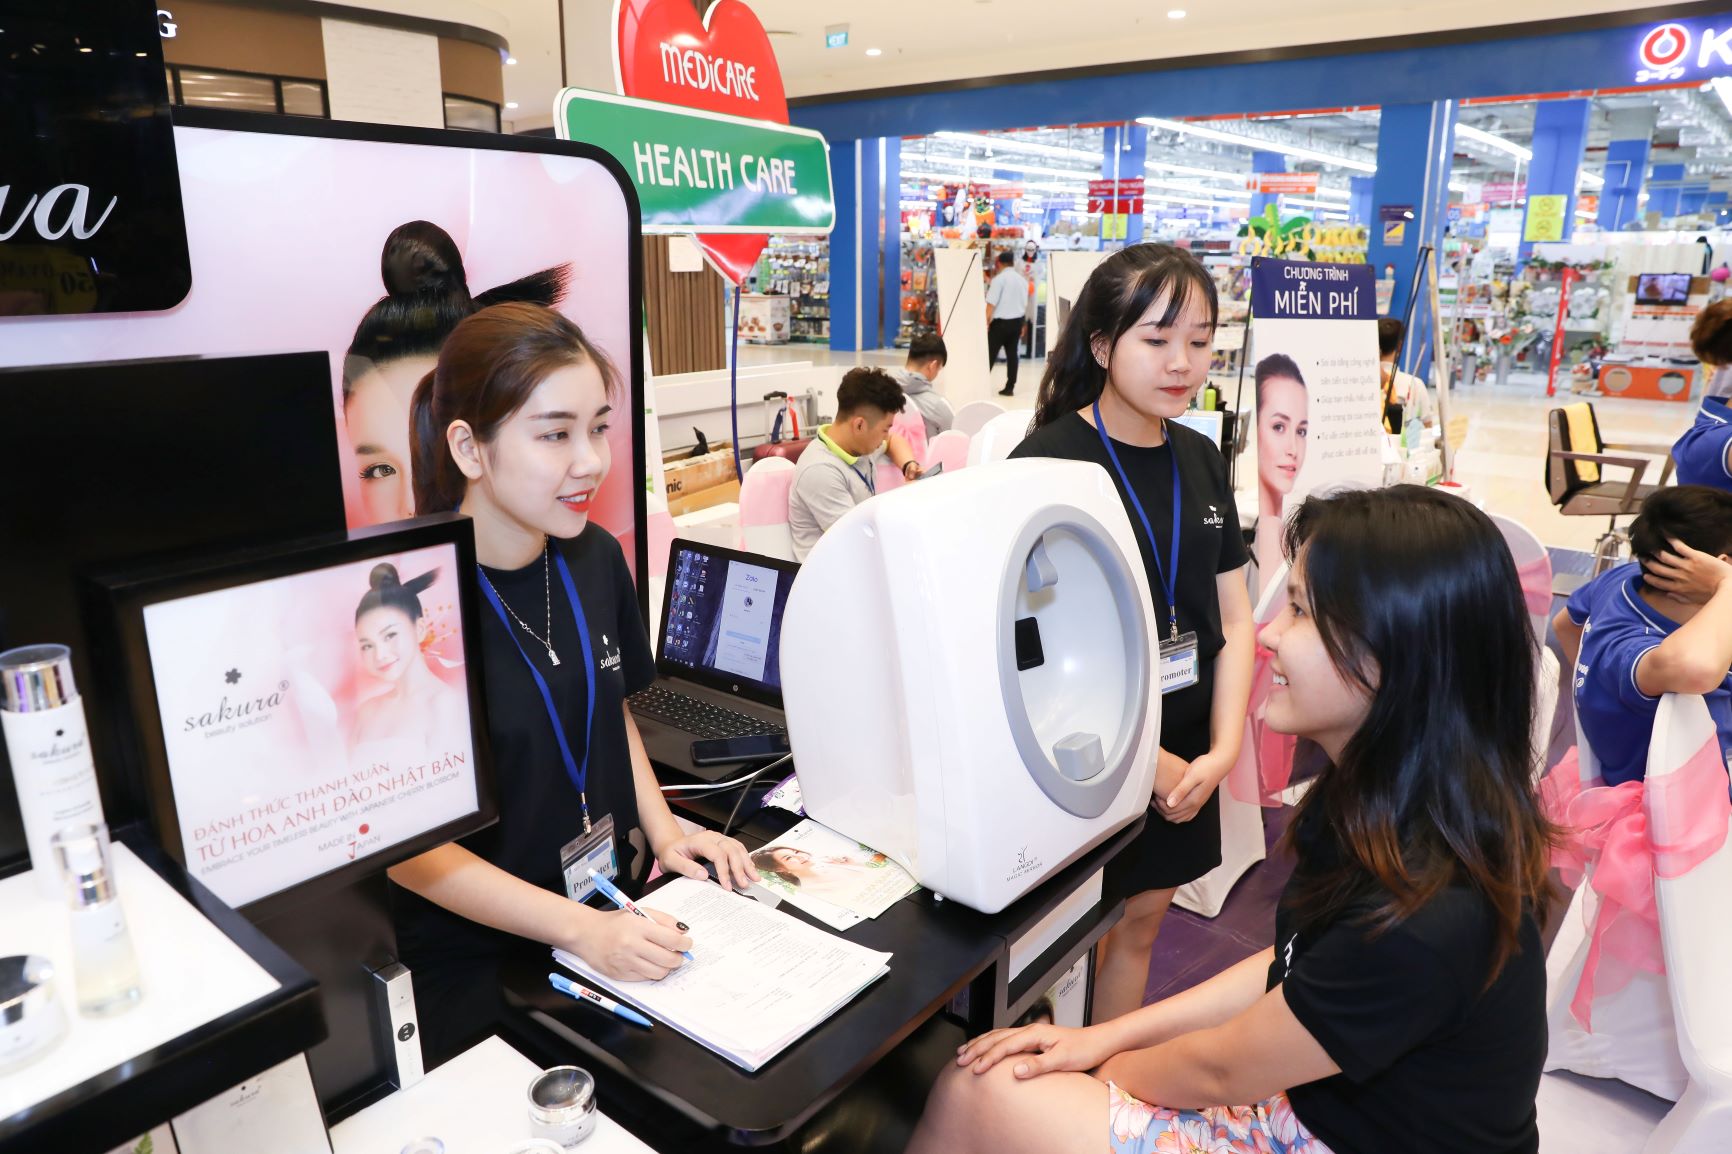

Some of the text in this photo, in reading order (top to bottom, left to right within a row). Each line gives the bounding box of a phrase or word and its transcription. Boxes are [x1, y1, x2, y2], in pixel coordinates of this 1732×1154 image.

[633, 141, 798, 195] HEALTH CARE
[1324, 266, 1349, 281] TRÌNH
[1275, 281, 1359, 315] MIỄN PHÍ
[204, 713, 273, 739] beauty solution
[194, 762, 390, 841] ĐÁNH THỨC THANH XUÂN
[197, 752, 465, 861] TỪ HOA ANH ĐÀO NHẬT BẢN
[201, 771, 460, 875] EMBRACE YOUR TIMELESS BEAUTY WITH JAPANESE CHERRY BLOSSOM
[318, 835, 345, 852] MADE
[348, 835, 382, 860] JAPAN
